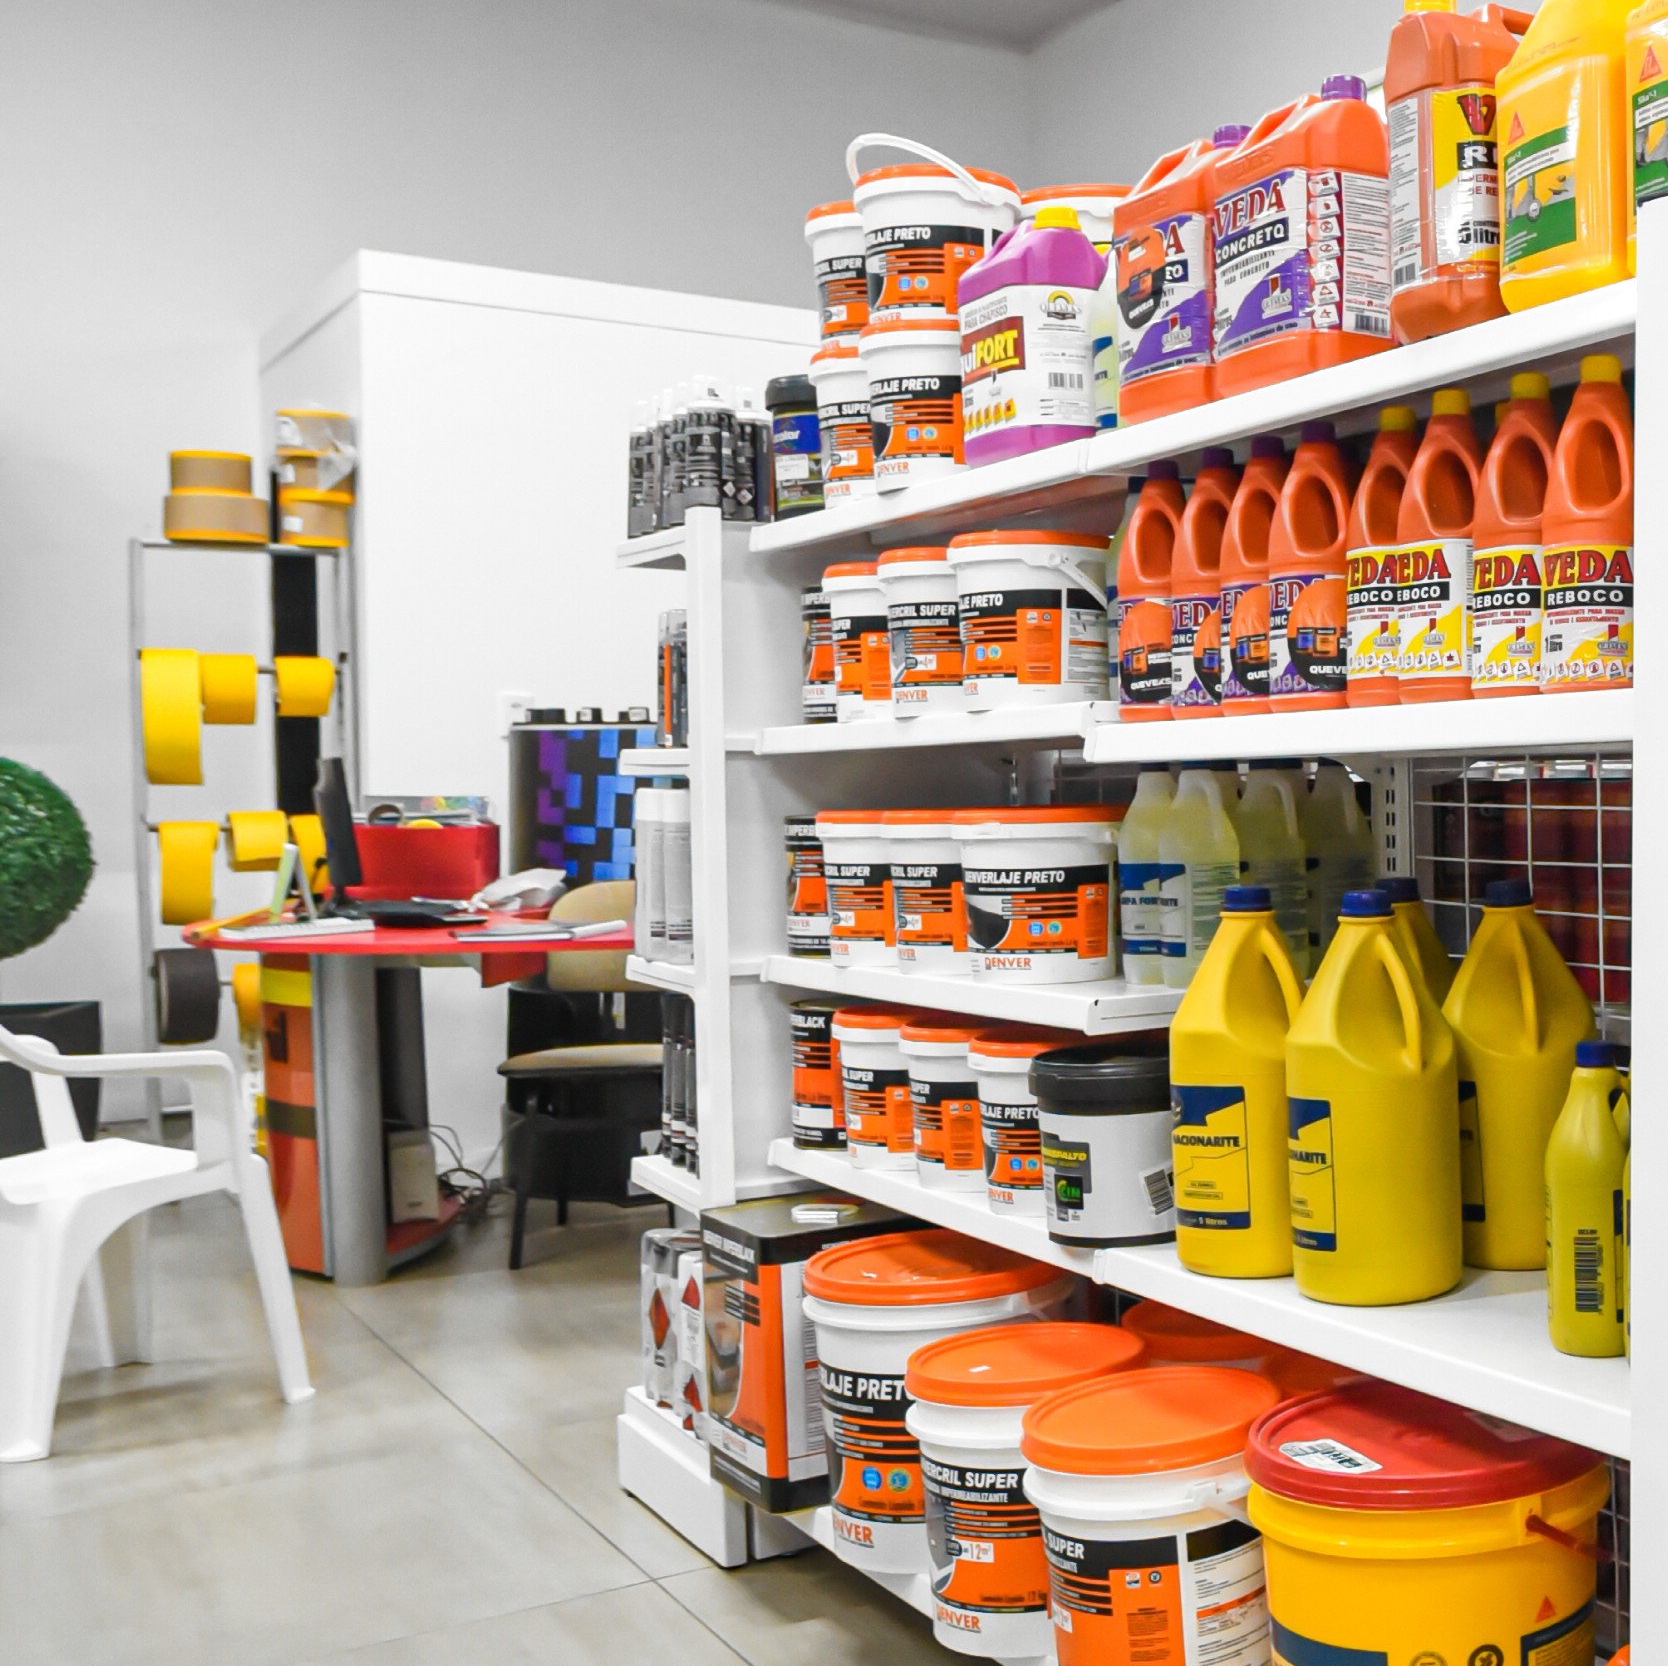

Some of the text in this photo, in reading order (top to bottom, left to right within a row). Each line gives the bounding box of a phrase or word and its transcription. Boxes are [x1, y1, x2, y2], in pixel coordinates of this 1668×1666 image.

[1214, 179, 1287, 240] VEDA
[893, 226, 932, 242] PRETO
[1216, 222, 1286, 265] CONCRETO
[901, 377, 941, 392] PRETO
[1543, 549, 1634, 588] VEDA
[970, 593, 1004, 609] PRETO
[1546, 588, 1625, 607] REBOCO
[919, 604, 956, 617] SUPER
[840, 865, 871, 878] SUPER
[907, 866, 938, 878] SUPER
[1023, 869, 1066, 885] PRETO
[964, 1470, 1019, 1490] SUPER
[1048, 1535, 1086, 1560] SUPER
